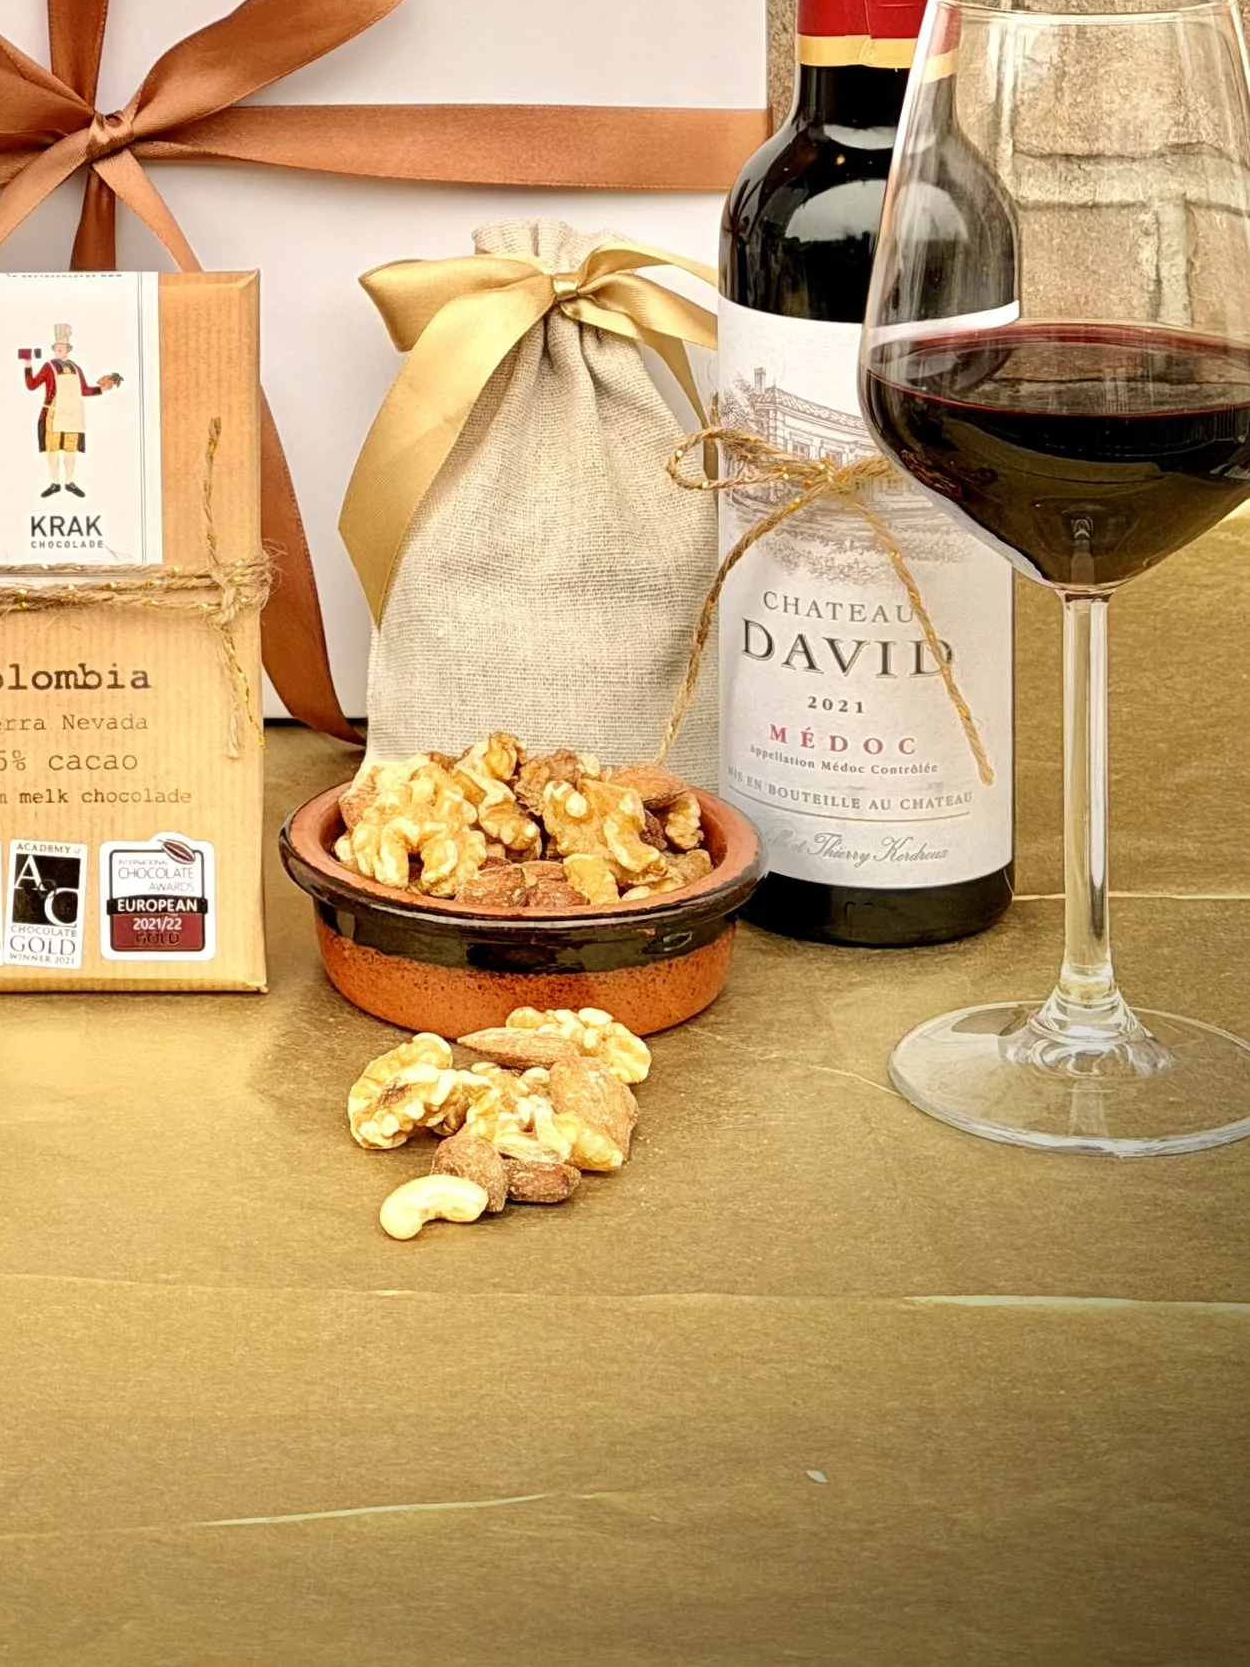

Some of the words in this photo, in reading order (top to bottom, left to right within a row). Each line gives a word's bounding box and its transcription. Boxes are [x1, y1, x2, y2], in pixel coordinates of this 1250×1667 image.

[30, 515, 103, 537] KRAK
[30, 539, 104, 549] CHOCOLADE
[763, 590, 915, 624] CHATEAU
[741, 617, 955, 679] DAVID
[807, 695, 865, 714] 2021
[62, 714, 149, 731] Nevada
[769, 723, 916, 755] MÉDOC
[48, 752, 138, 771] cacao
[750, 743, 816, 769] Appellation
[821, 760, 865, 774] Médoc
[870, 763, 938, 775] Contrôlée
[19, 789, 69, 804] melk
[81, 788, 192, 804] chocolade
[728, 765, 743, 782] MIS
[747, 775, 762, 792] EN
[768, 785, 861, 810] BOUTEILLE
[868, 799, 891, 810] AU
[899, 791, 973, 810] CHATEAU
[16, 842, 71, 854] ACADEMY
[118, 867, 194, 879] CHOCOLATE
[149, 882, 195, 892] AWARDS
[117, 899, 198, 912] EUROPEAN
[10, 925, 77, 937] CHOCOLATE
[133, 916, 182, 933] 2021/22
[9, 935, 76, 956] GOLD
[135, 932, 180, 944] GOLD
[9, 952, 51, 963] WINNER
[54, 956, 75, 965] 2021
